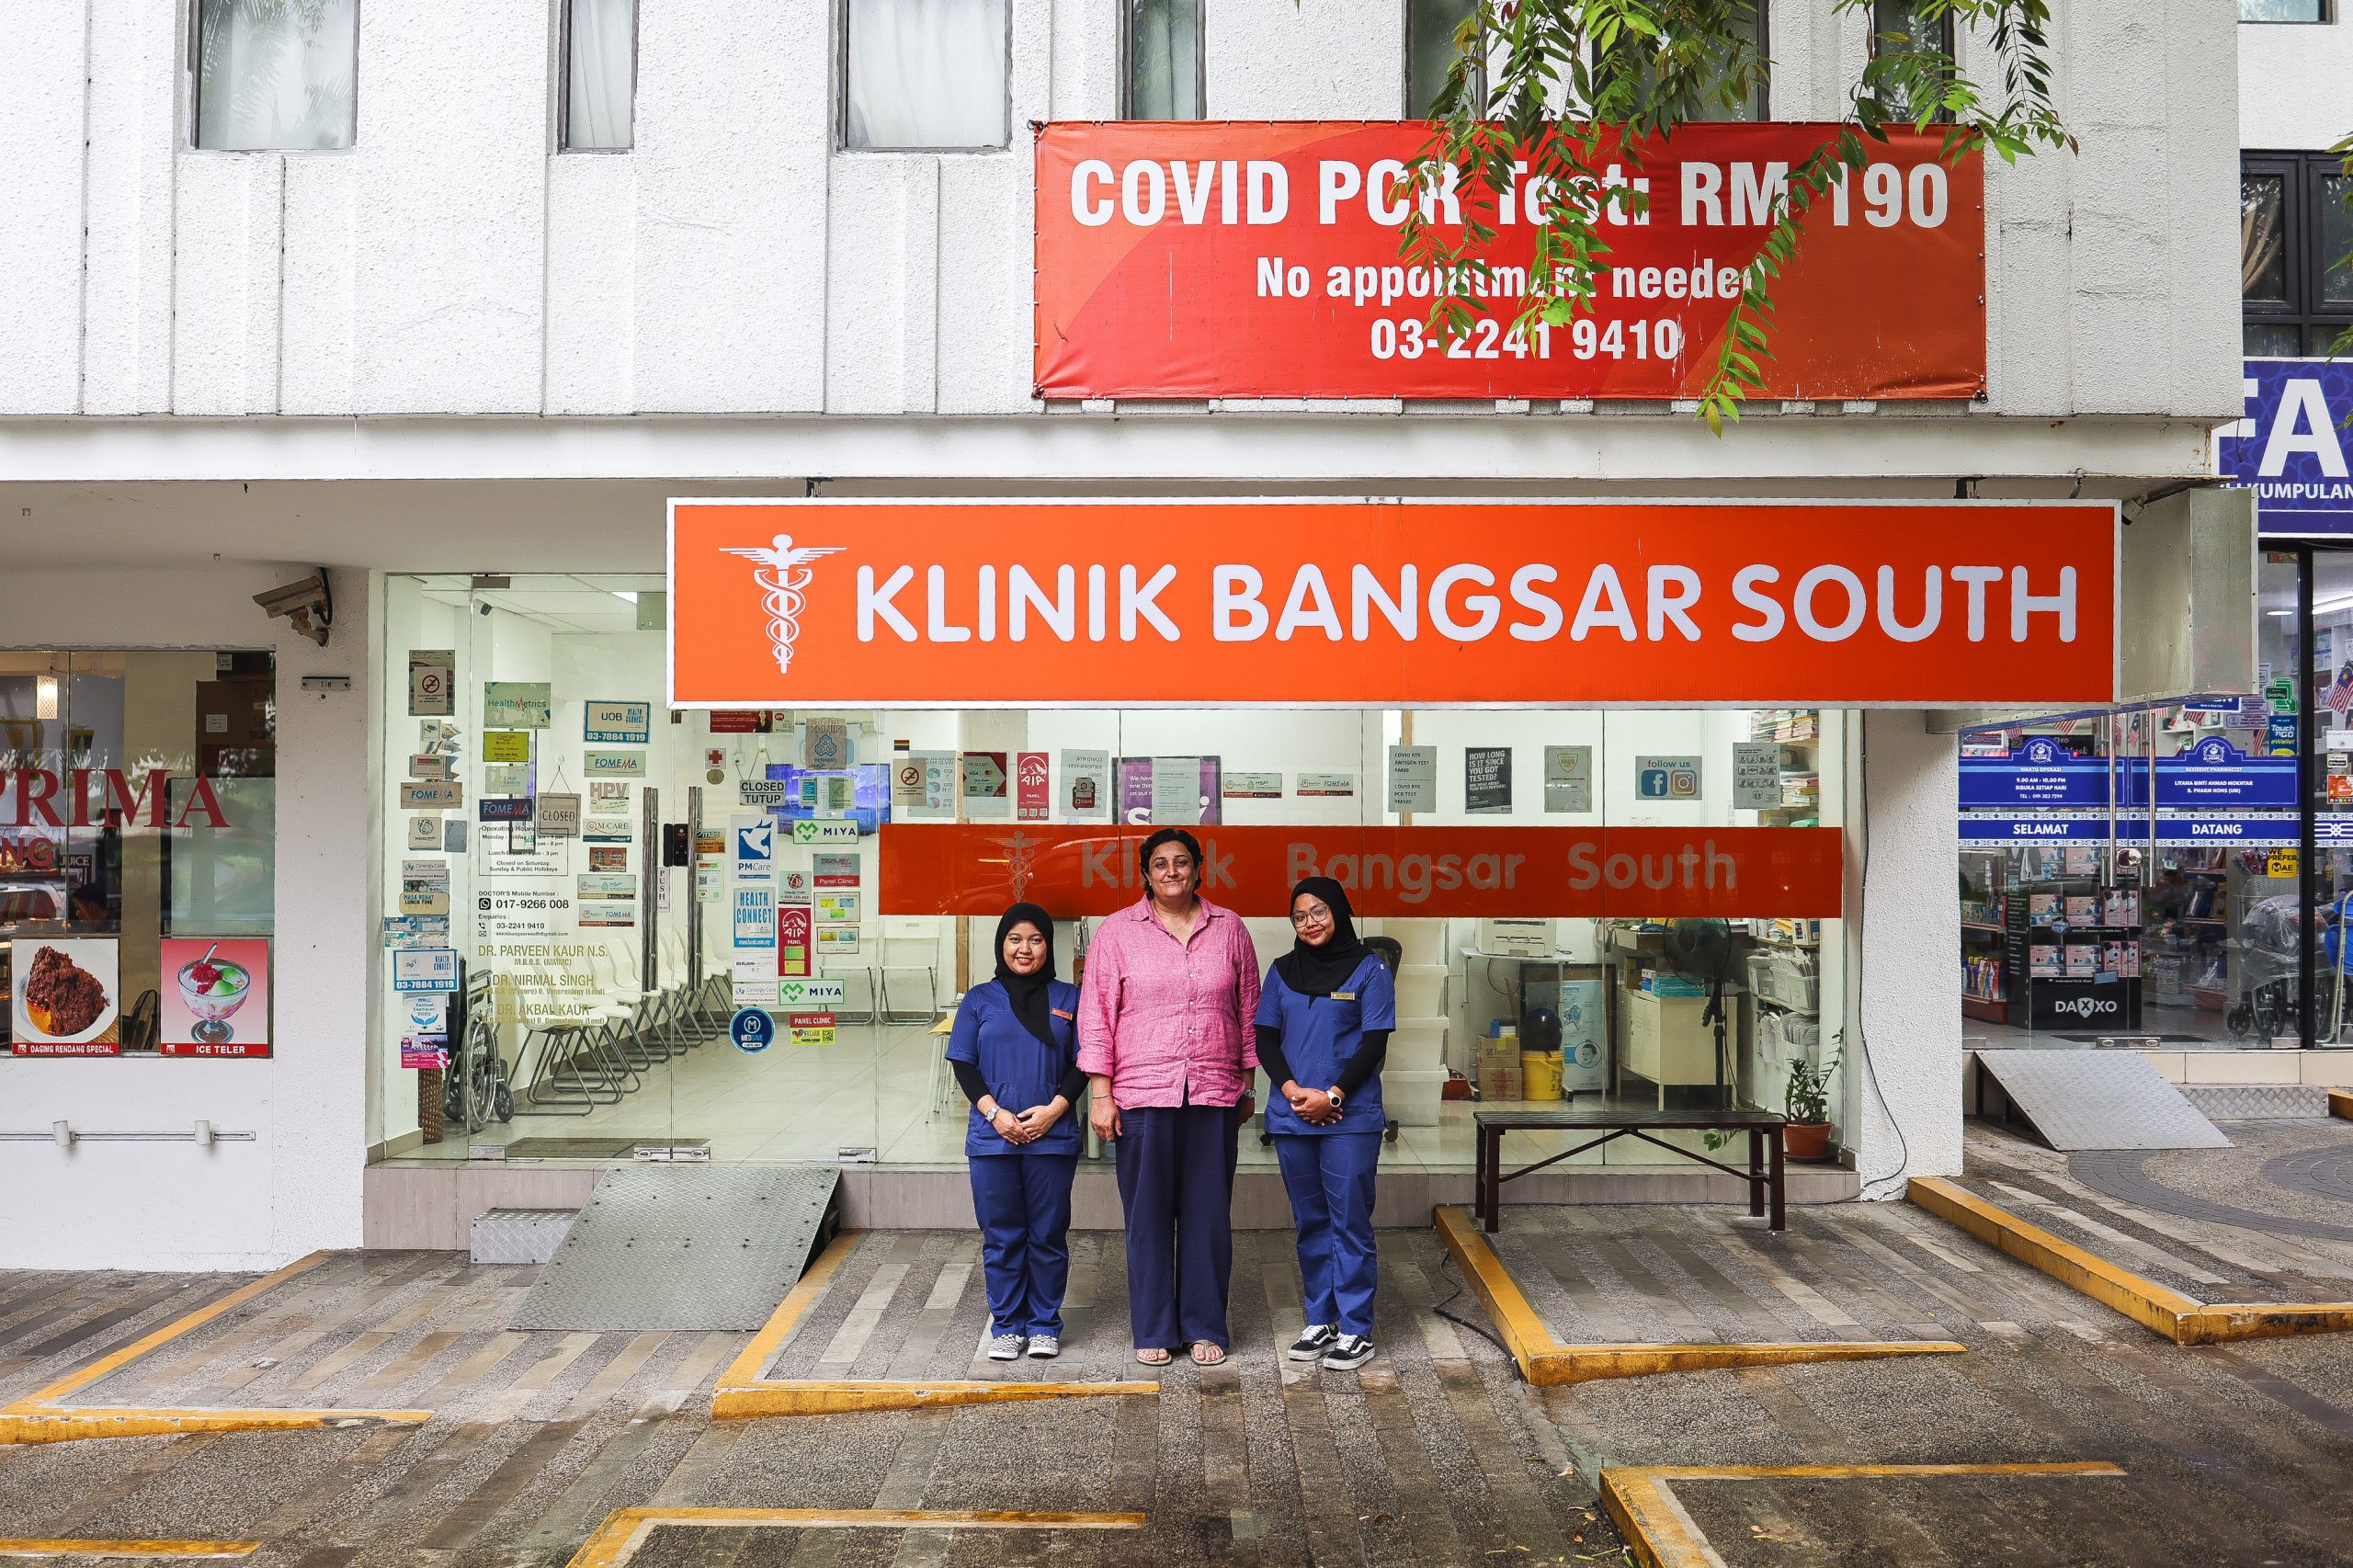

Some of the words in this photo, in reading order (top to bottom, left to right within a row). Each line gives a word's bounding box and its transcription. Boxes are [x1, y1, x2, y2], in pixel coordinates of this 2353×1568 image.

[1071, 159, 1289, 226] COVID
[1319, 159, 1463, 226] PCR
[1680, 161, 1790, 226] RM
[1825, 162, 1948, 228] 190
[1256, 256, 1310, 298] No
[1370, 318, 1551, 359] 03-2241
[1572, 318, 1681, 359] 9410
[858, 563, 1181, 642] KLINIK
[1213, 562, 1702, 642] BANGSAR
[1730, 562, 2077, 643] SOUTH
[488, 697, 546, 711] HealthMetrics
[601, 711, 622, 721] UOB
[811, 725, 842, 733] KLINIK
[587, 732, 623, 741] 03-7884
[625, 733, 645, 742] 1919
[1469, 752, 1485, 760] HOW
[1486, 750, 1506, 759] LONG
[595, 756, 637, 769] FOMEMA
[1469, 759, 1476, 768] IS
[1477, 759, 1484, 767] IT
[1485, 757, 1505, 767] SINCE
[1647, 759, 1677, 767] follow
[1469, 767, 1483, 776] YOU
[1484, 766, 1498, 775] GOT
[1021, 776, 1045, 787] AIA
[1469, 774, 1497, 783] TESTED?
[589, 782, 628, 799] HPV
[742, 782, 784, 791] CLOSED
[0, 768, 232, 828] RIMA
[745, 794, 781, 803] TUTUP
[483, 802, 529, 815] FOMEMA
[542, 809, 576, 823] CLOSED
[824, 827, 856, 835] MIYA
[2013, 824, 2069, 835] SELAMAT
[2191, 824, 2243, 835] DATANG
[1, 836, 54, 867] NG
[60, 856, 90, 867] JUICE
[738, 862, 771, 871] PMCare
[1287, 842, 1526, 903] Bangsar
[1567, 839, 1737, 890] South
[496, 900, 547, 909] 017-9266
[549, 900, 570, 909] 008
[740, 892, 768, 906] HEALTH
[736, 908, 772, 924] CONNECT
[784, 927, 805, 937] AIA
[478, 945, 497, 957] DR.
[500, 945, 551, 957] PARVEEN
[553, 945, 585, 957] KAUR
[587, 946, 608, 957] N.S.
[435, 955, 449, 963] HEALTH
[514, 958, 542, 966] M.B.B.S.
[433, 962, 451, 971] CONNECT
[396, 980, 433, 989] 03-7884
[434, 980, 454, 989] 1919
[493, 974, 511, 986] DR.
[514, 974, 556, 986] NIRMAL
[559, 974, 595, 986] SINGH
[810, 987, 843, 995] MIYA
[497, 1004, 515, 1016] DR.
[518, 1004, 555, 1016] AKBAL
[558, 1004, 589, 1016] KAUR
[2055, 999, 2118, 1014] DAXXO
[30, 1045, 53, 1054] DAGING
[55, 1045, 85, 1054] RENDANG
[85, 1045, 114, 1054] SPECIAL
[196, 1045, 211, 1054] ICE
[213, 1045, 245, 1054] TELER
